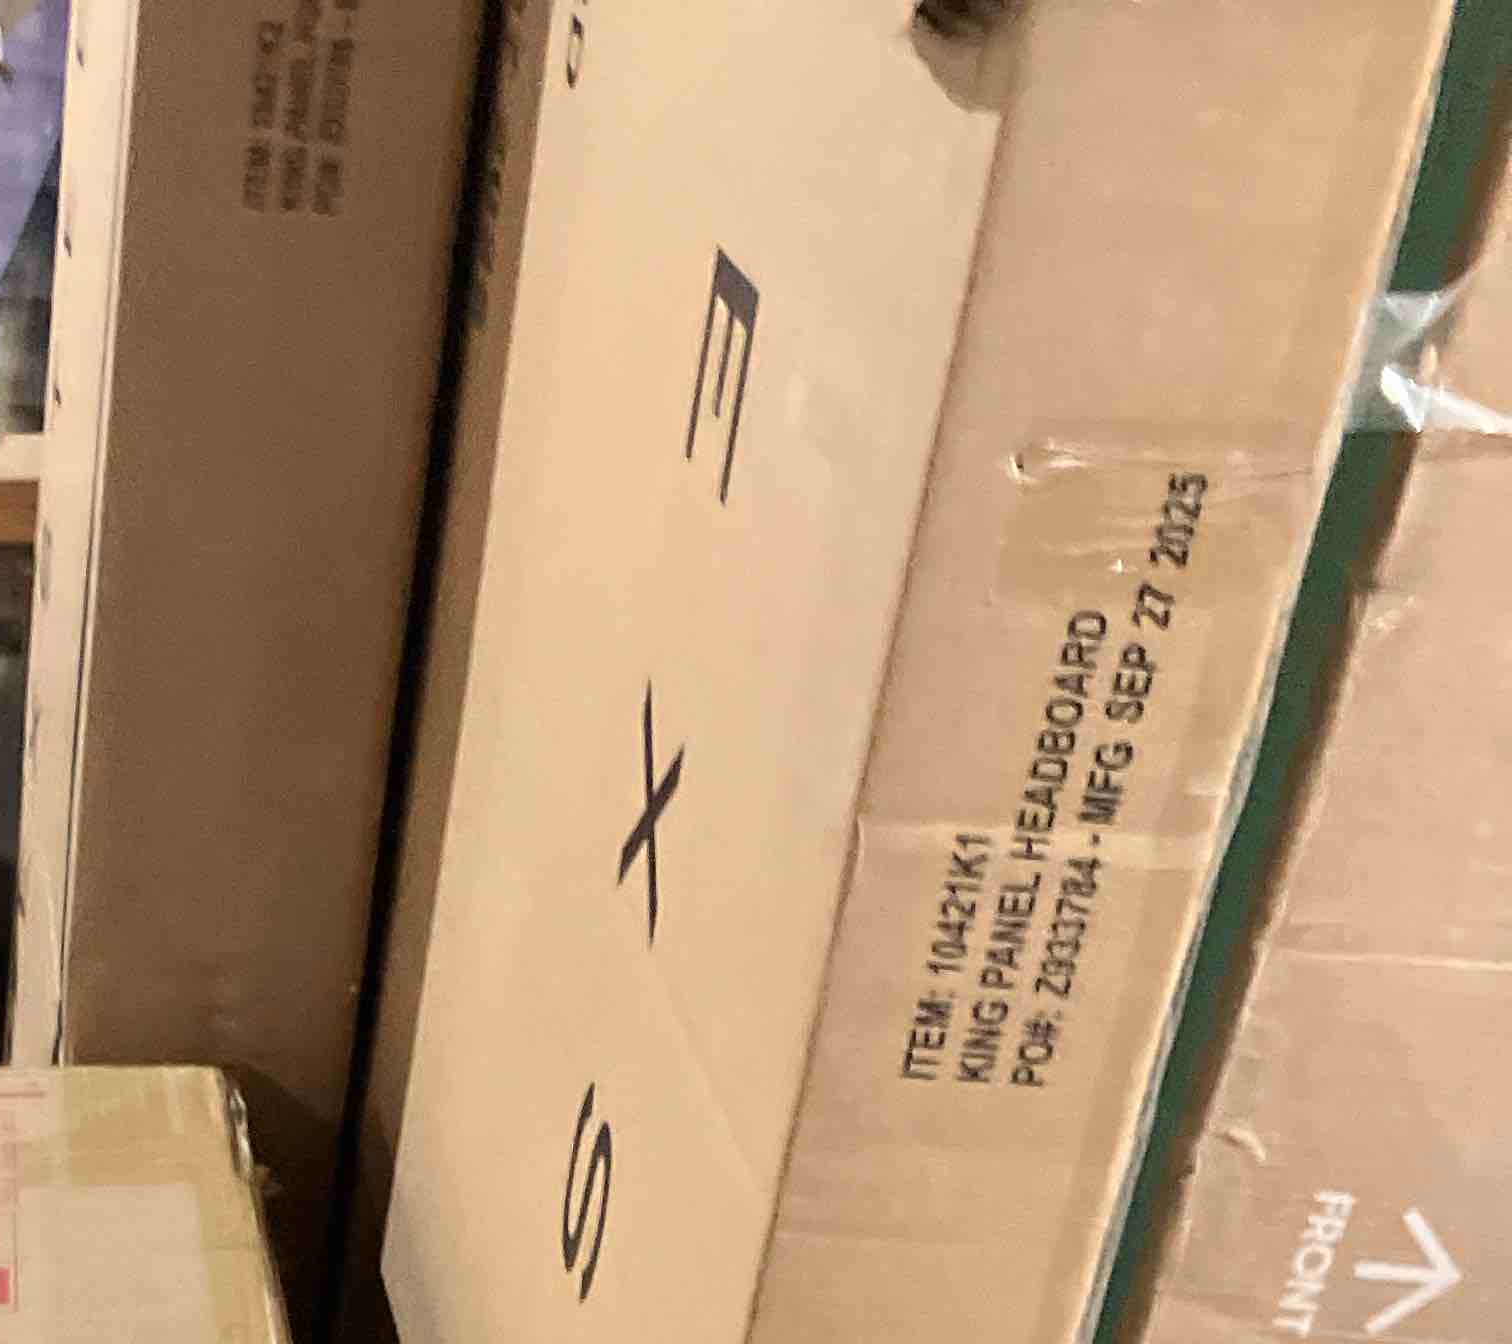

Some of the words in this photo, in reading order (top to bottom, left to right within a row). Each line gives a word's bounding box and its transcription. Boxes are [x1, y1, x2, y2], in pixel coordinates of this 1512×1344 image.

[1148, 472, 1209, 568] 2025
[1131, 583, 1175, 630] 27
[1104, 645, 1156, 724] SEP
[1009, 610, 1109, 860] HEADBOARD
[1080, 742, 1132, 825] MFG
[926, 831, 992, 976] 10421K1
[979, 873, 1042, 990] PANEL
[1034, 856, 1102, 998] Z933784
[899, 990, 955, 1082] ITEM:
[957, 999, 1009, 1084] KING
[1009, 1009, 1062, 1088] PO#:
[1272, 1190, 1357, 1337] FRONT
